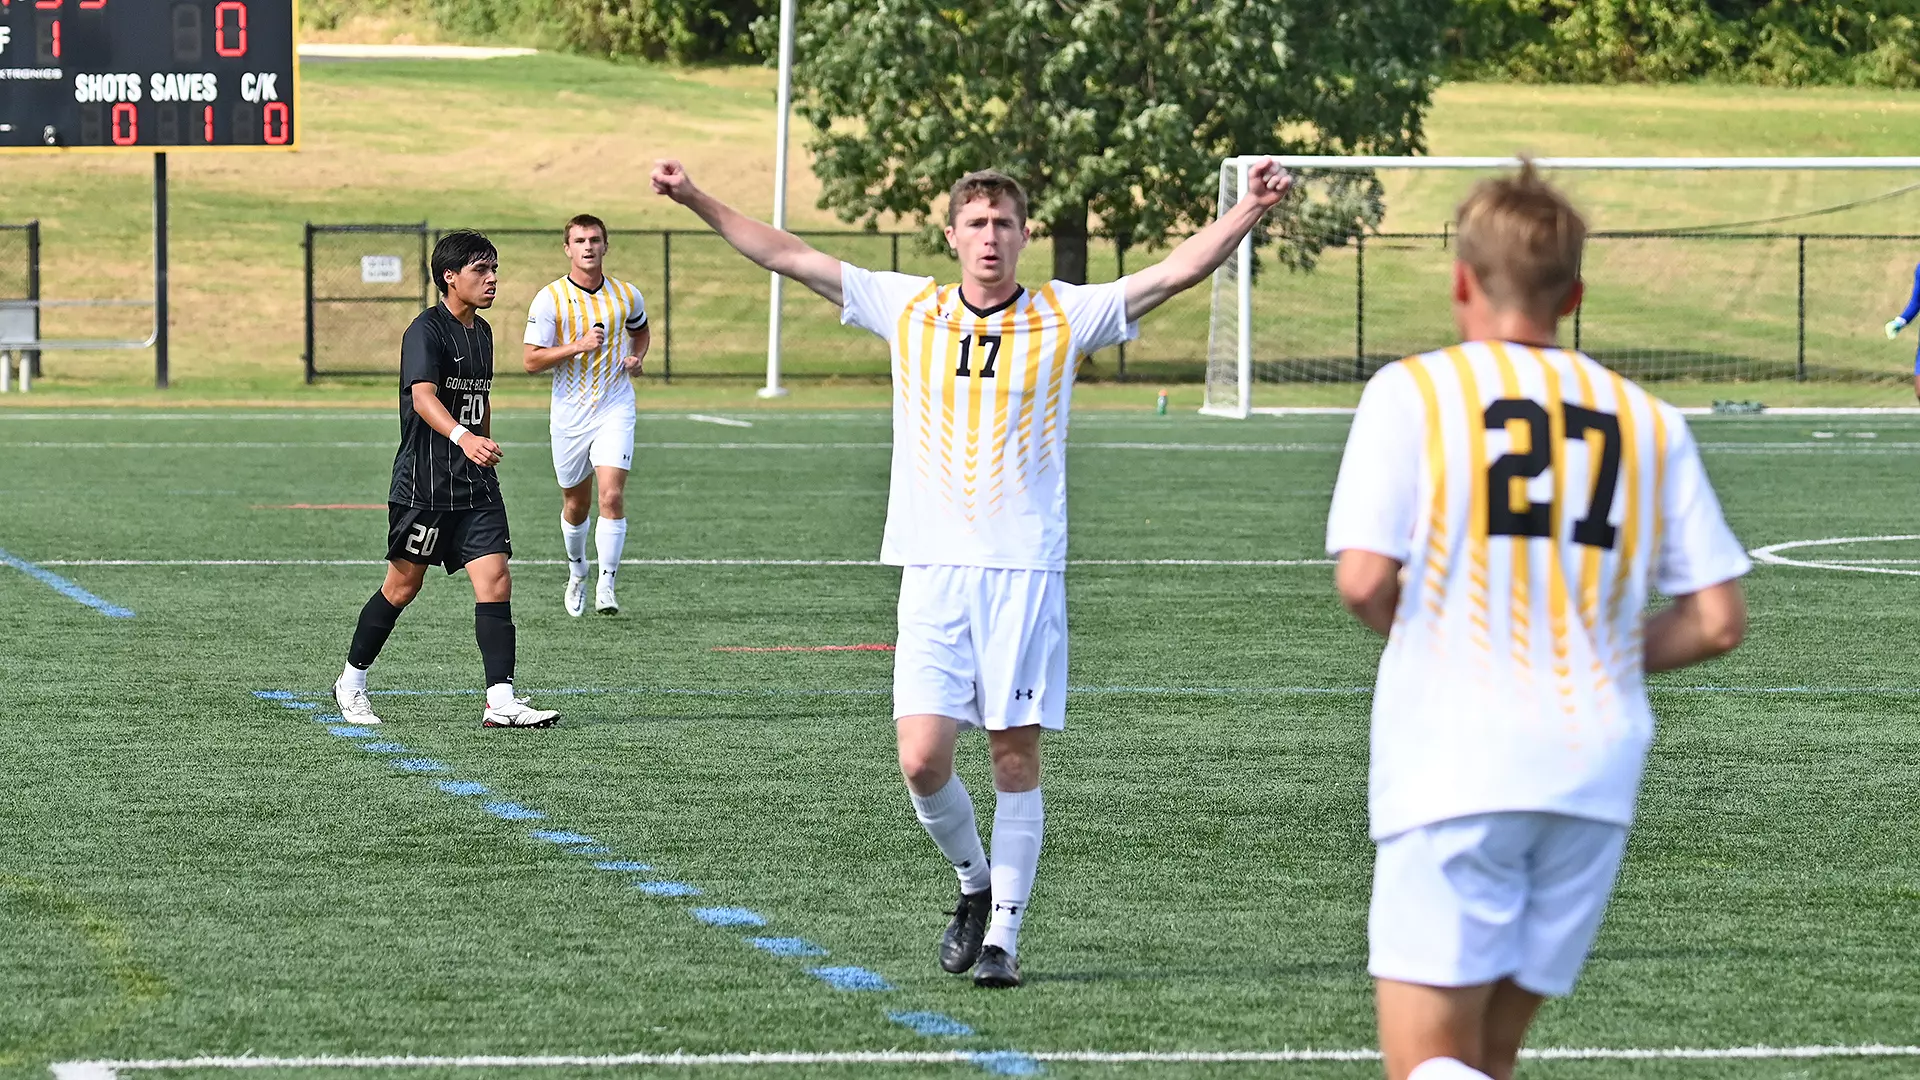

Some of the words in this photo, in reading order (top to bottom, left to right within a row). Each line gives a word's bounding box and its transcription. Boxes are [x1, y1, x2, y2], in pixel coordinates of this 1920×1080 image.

[52, 20, 61, 58] 1
[215, 1, 247, 57] 0
[74, 73, 142, 103] SHOTS
[150, 73, 217, 103] SAVES
[240, 72, 278, 104] C/K
[111, 102, 138, 146] 0
[204, 105, 214, 143] 1
[263, 102, 289, 145] 0
[956, 334, 1001, 378] 17
[459, 393, 484, 425] 20
[1484, 398, 1621, 549] 27
[405, 522, 439, 556] 20
